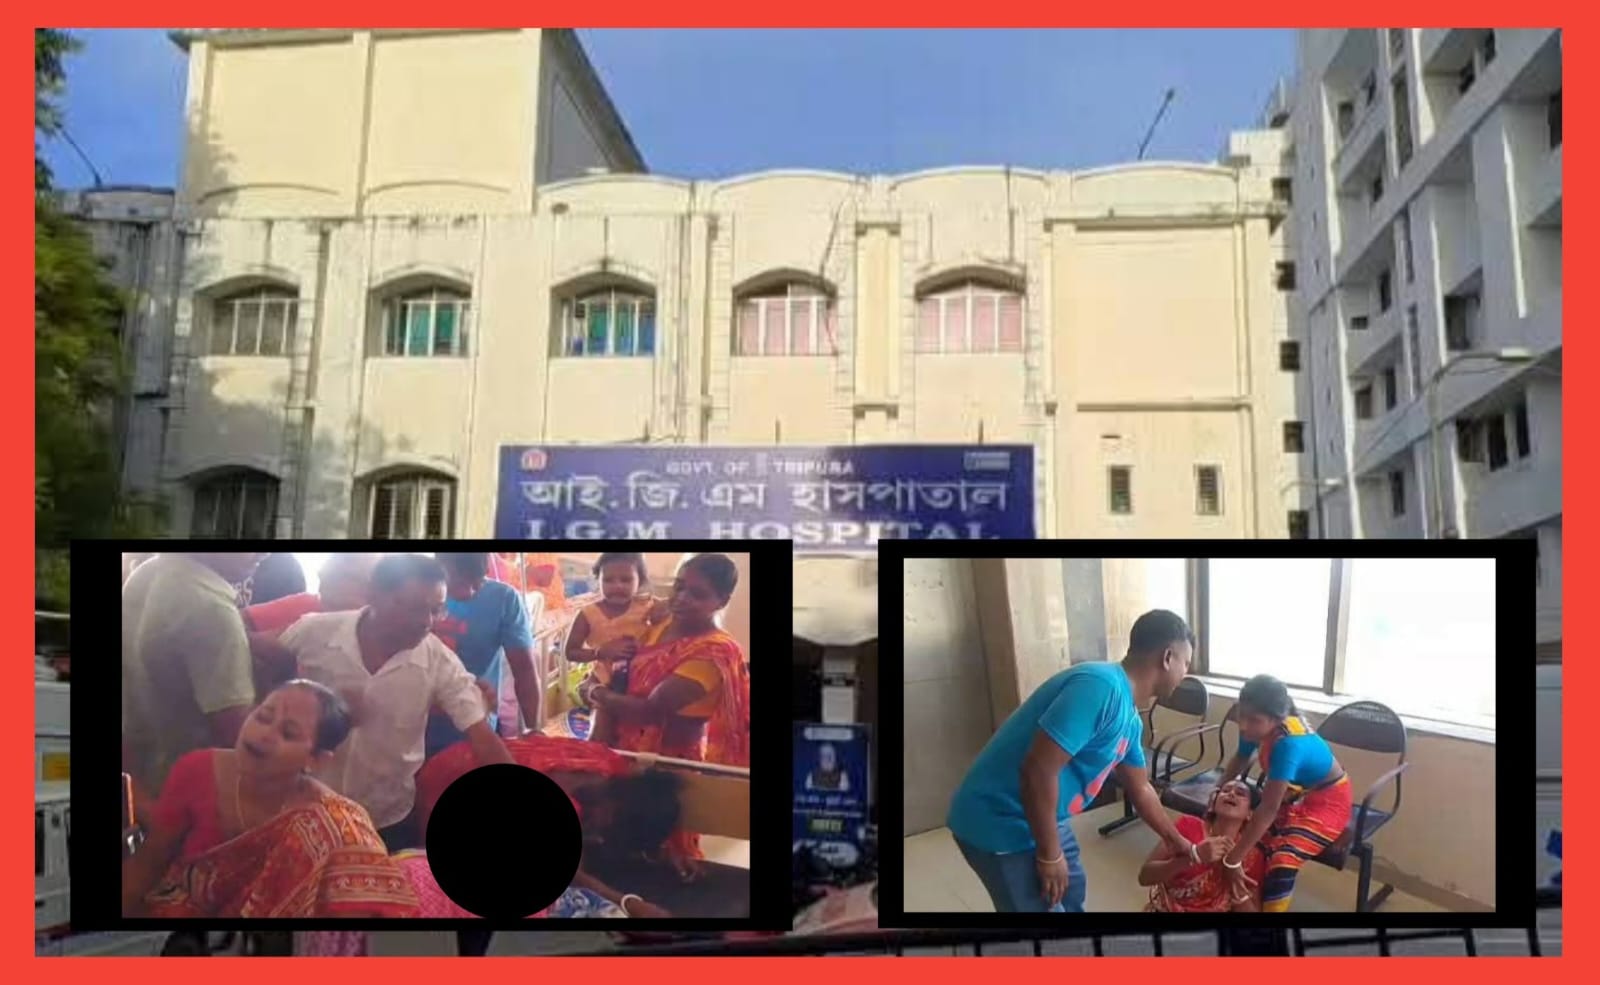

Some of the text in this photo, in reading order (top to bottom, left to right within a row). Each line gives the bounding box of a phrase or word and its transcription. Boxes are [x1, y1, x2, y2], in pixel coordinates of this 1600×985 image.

[724, 460, 751, 475] OF
[773, 459, 855, 475] TRIPURA
[788, 476, 1010, 514] হাসপাতাল
[709, 520, 999, 546] HOSPITAL
